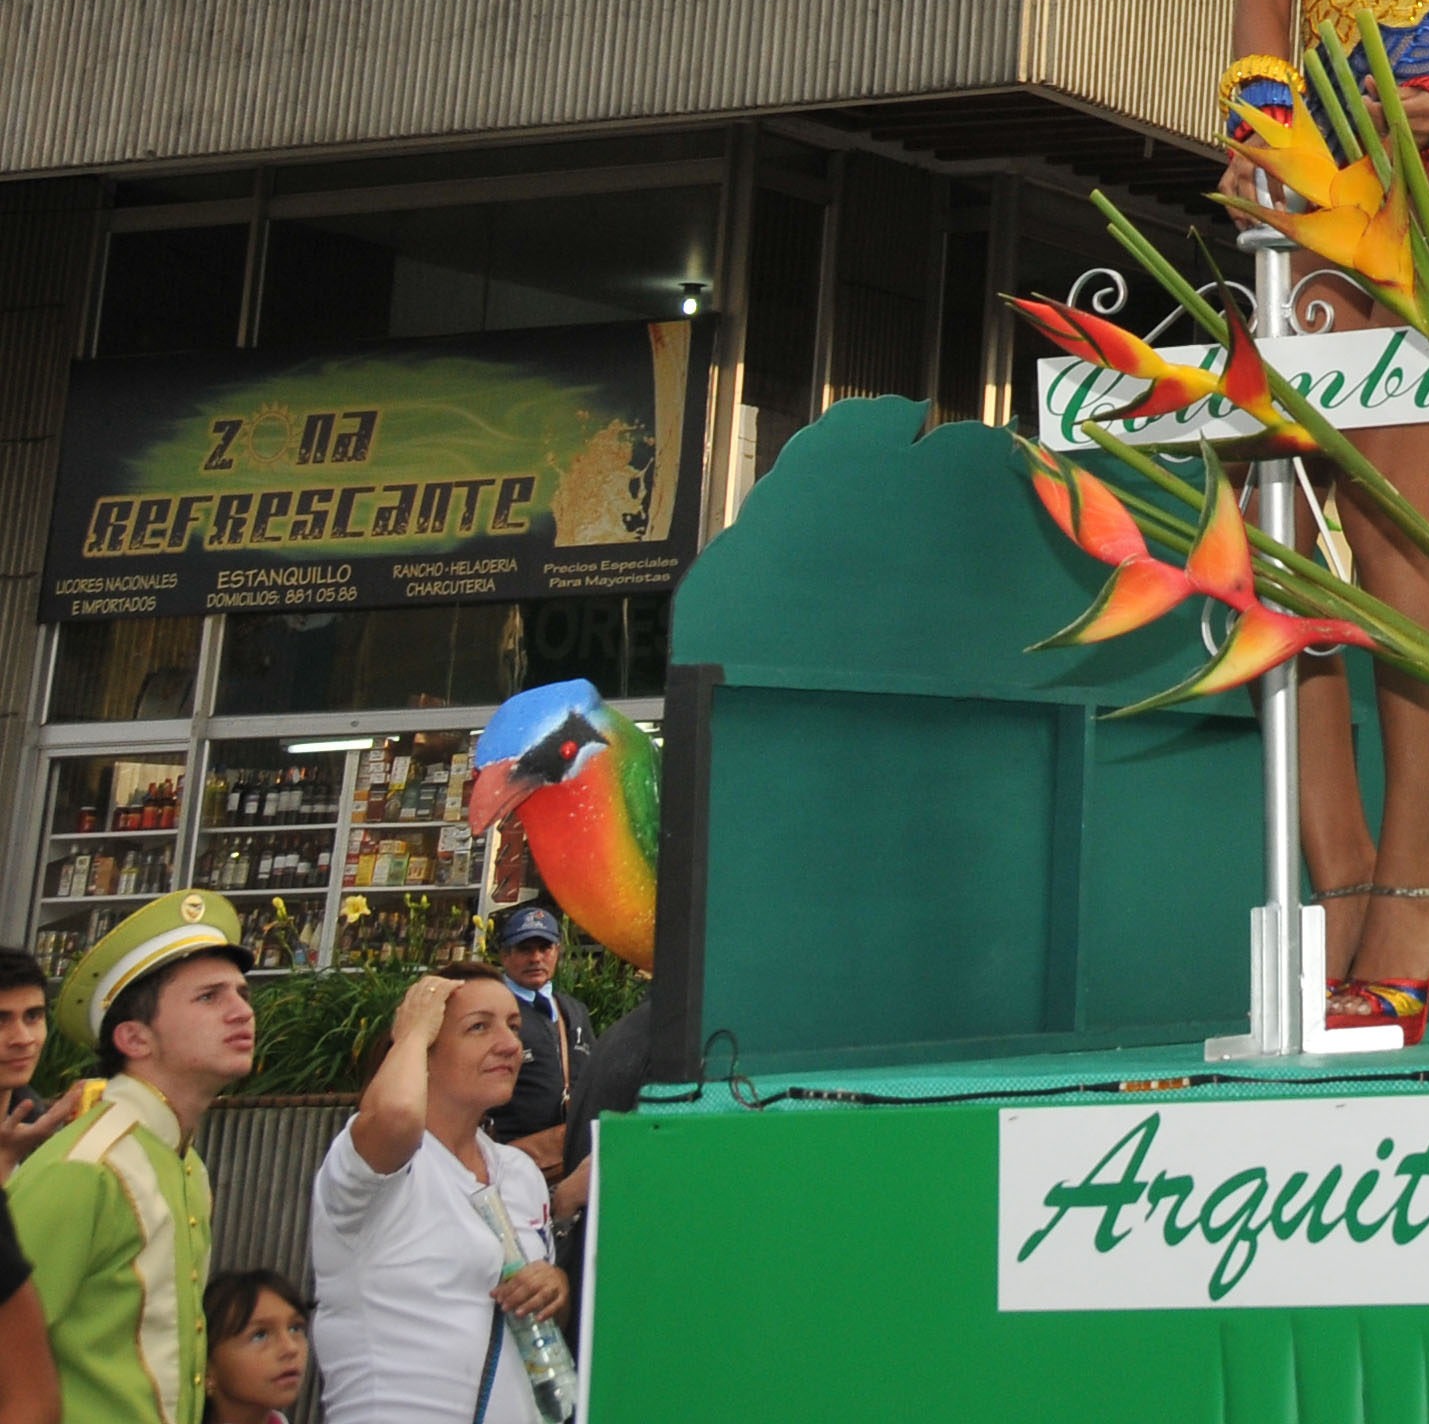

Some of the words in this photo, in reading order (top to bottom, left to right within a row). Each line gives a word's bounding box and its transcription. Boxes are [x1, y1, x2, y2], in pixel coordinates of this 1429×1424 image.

[543, 562, 598, 574] Precios
[600, 557, 679, 574] Especiales
[56, 577, 104, 595] LICORES
[105, 573, 179, 592] NACIONALES
[216, 564, 352, 589] ESTANQUILLO
[548, 577, 582, 588] Para
[585, 573, 671, 588] Mayoristas
[206, 590, 280, 608] DOMICILIOS:
[284, 588, 313, 604] 881
[316, 587, 336, 602] 05
[337, 586, 358, 602] 88
[406, 577, 496, 597] CHARCUTERIA
[72, 600, 81, 616] E
[81, 596, 157, 614] IMPORTADOS
